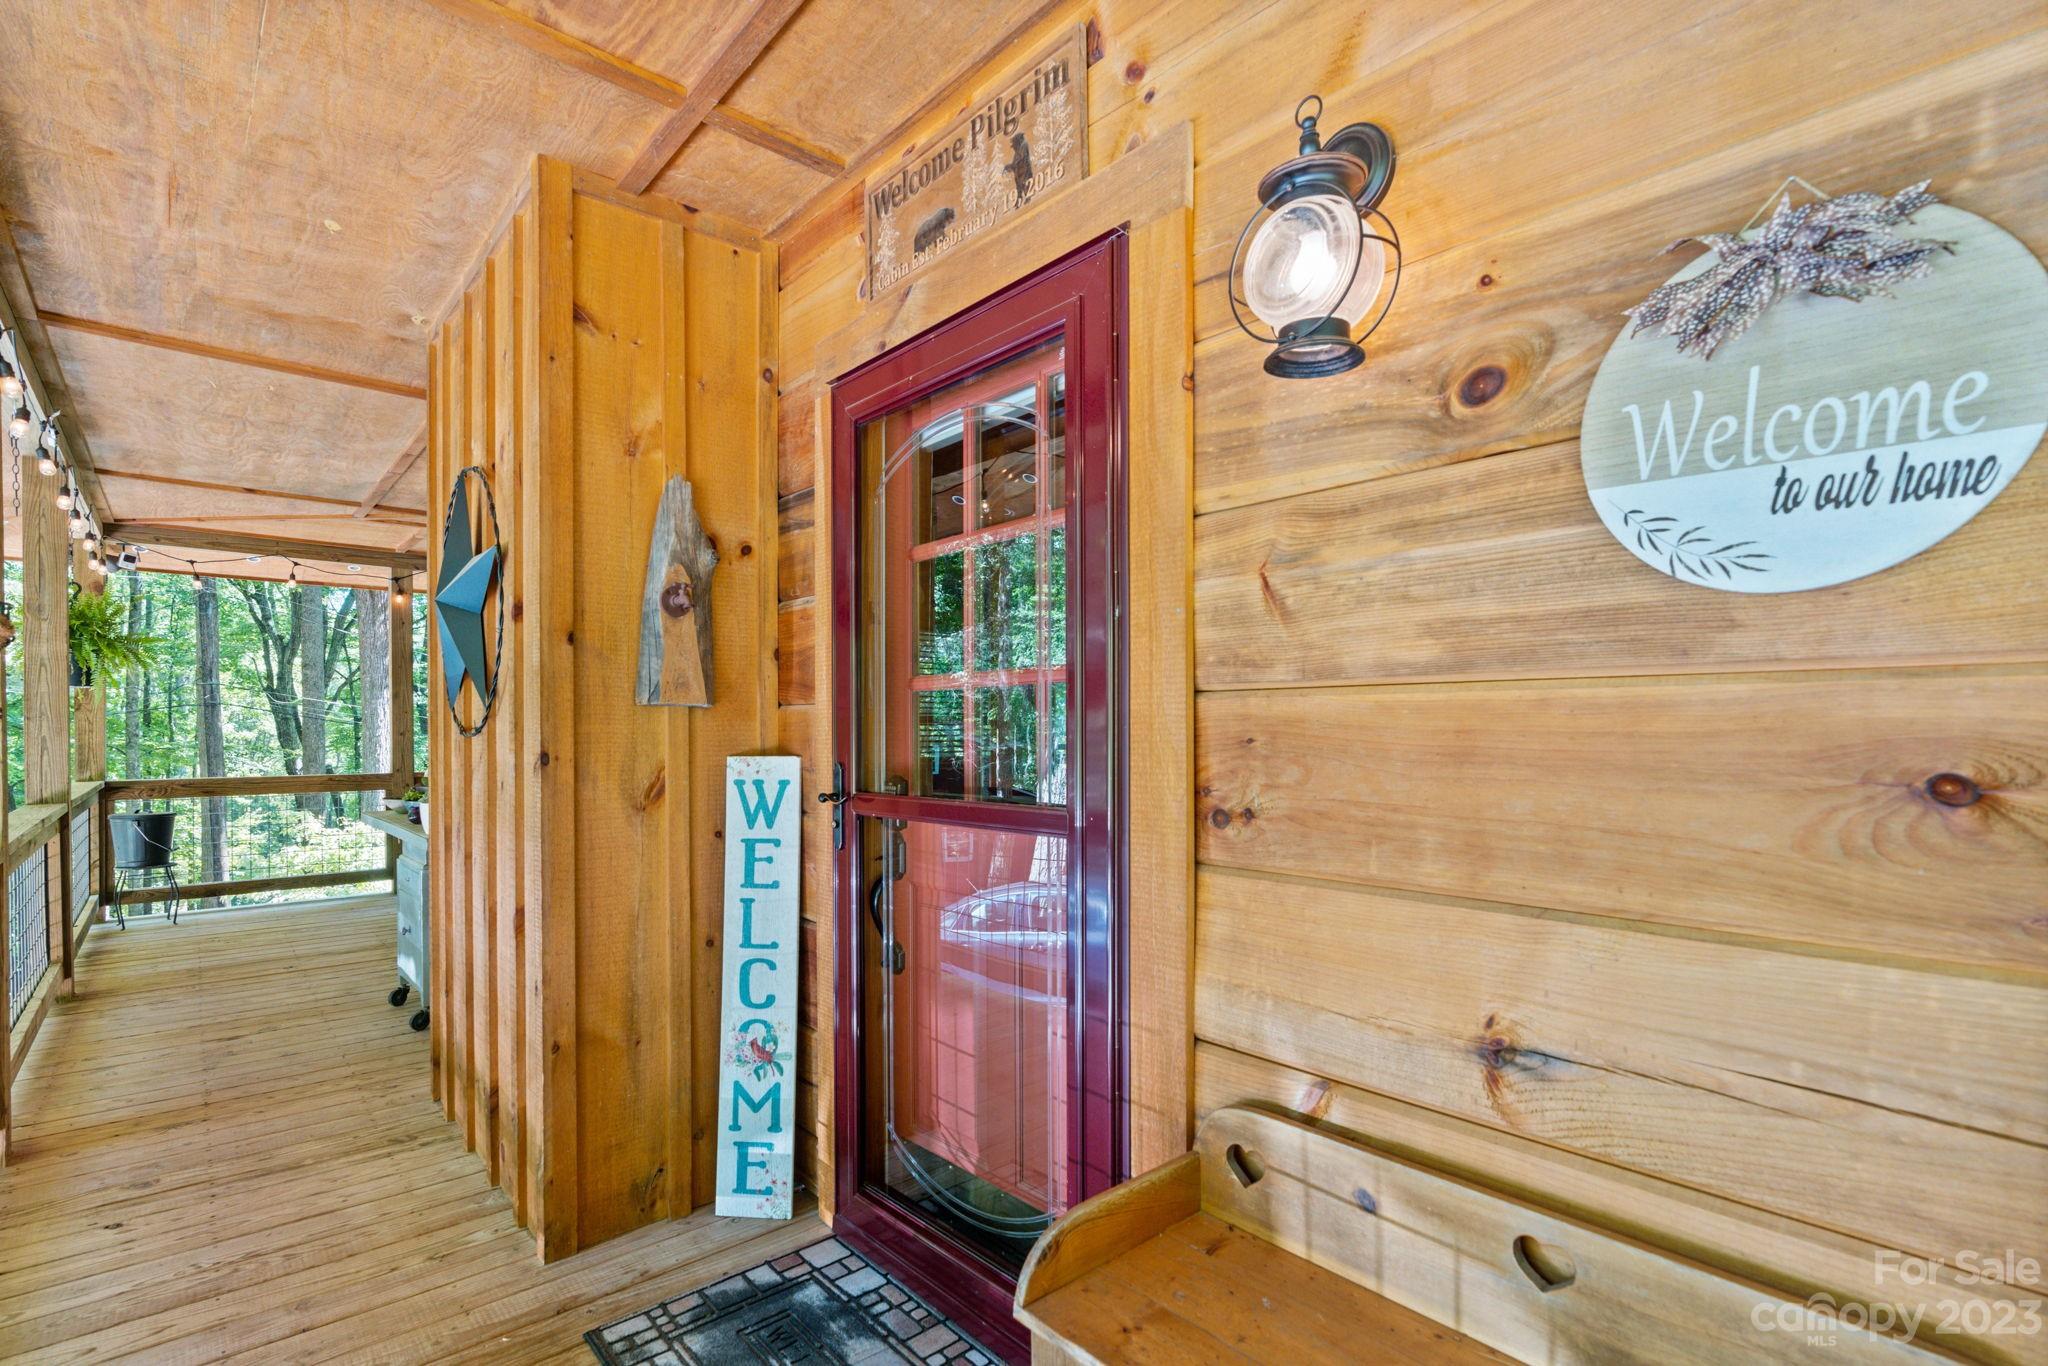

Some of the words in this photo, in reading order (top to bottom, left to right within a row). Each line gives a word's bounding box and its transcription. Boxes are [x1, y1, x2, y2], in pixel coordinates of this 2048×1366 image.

[874, 138, 965, 217] Welcome
[971, 57, 1071, 150] Pilgrim
[878, 262, 909, 291] Cabin
[912, 247, 934, 271] Est.
[936, 206, 998, 254] February
[1003, 192, 1022, 215] 19,
[1026, 162, 1065, 198] 2016
[1622, 366, 1989, 480] Welcome
[1770, 465, 1809, 515] to
[1815, 455, 1884, 513] our
[1889, 451, 2002, 505] home
